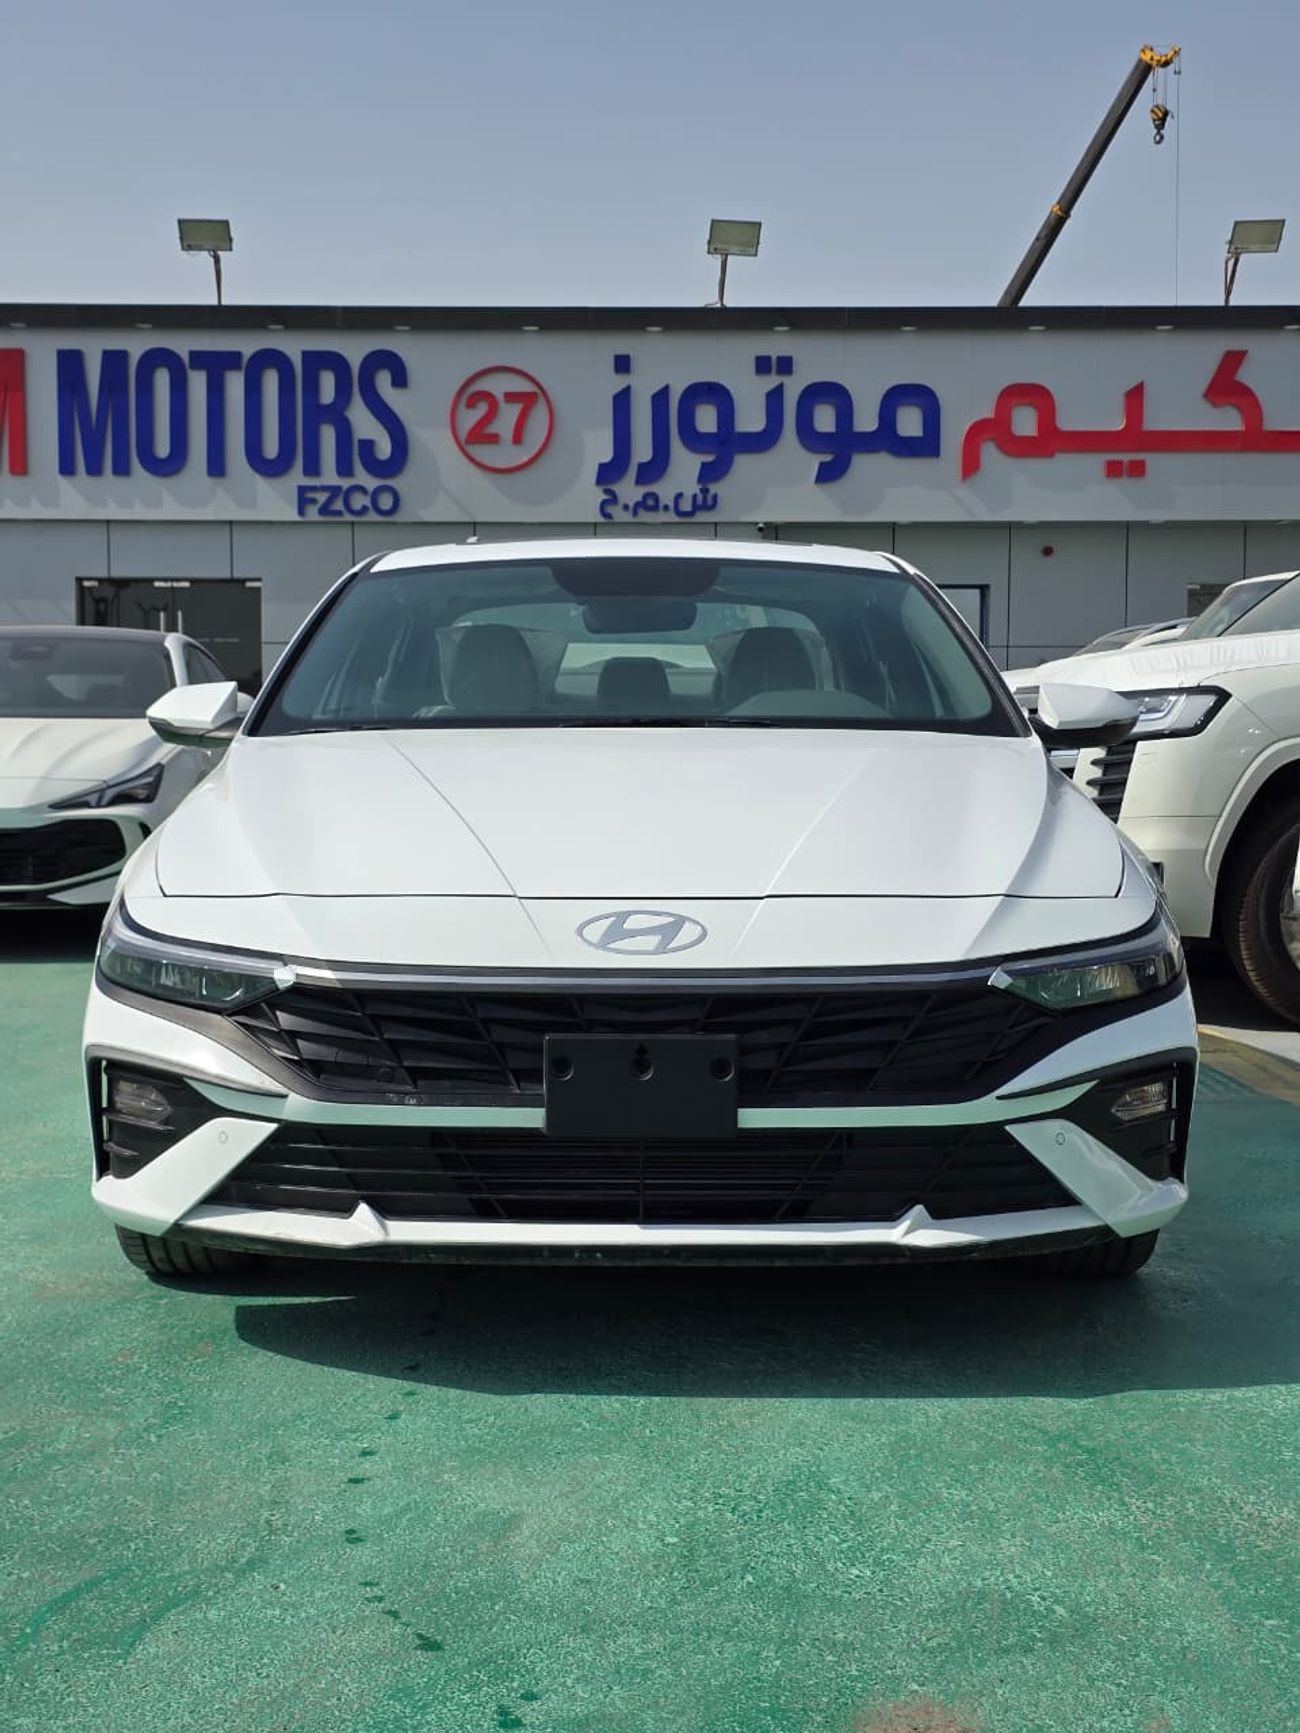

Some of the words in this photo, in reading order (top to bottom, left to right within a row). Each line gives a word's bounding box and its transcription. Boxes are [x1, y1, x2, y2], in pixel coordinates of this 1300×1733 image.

[56, 347, 409, 478] MOTORS
[464, 390, 538, 445] 27
[594, 354, 942, 486] موتورز
[958, 349, 1300, 481] كيم
[297, 484, 400, 517] FZCO
